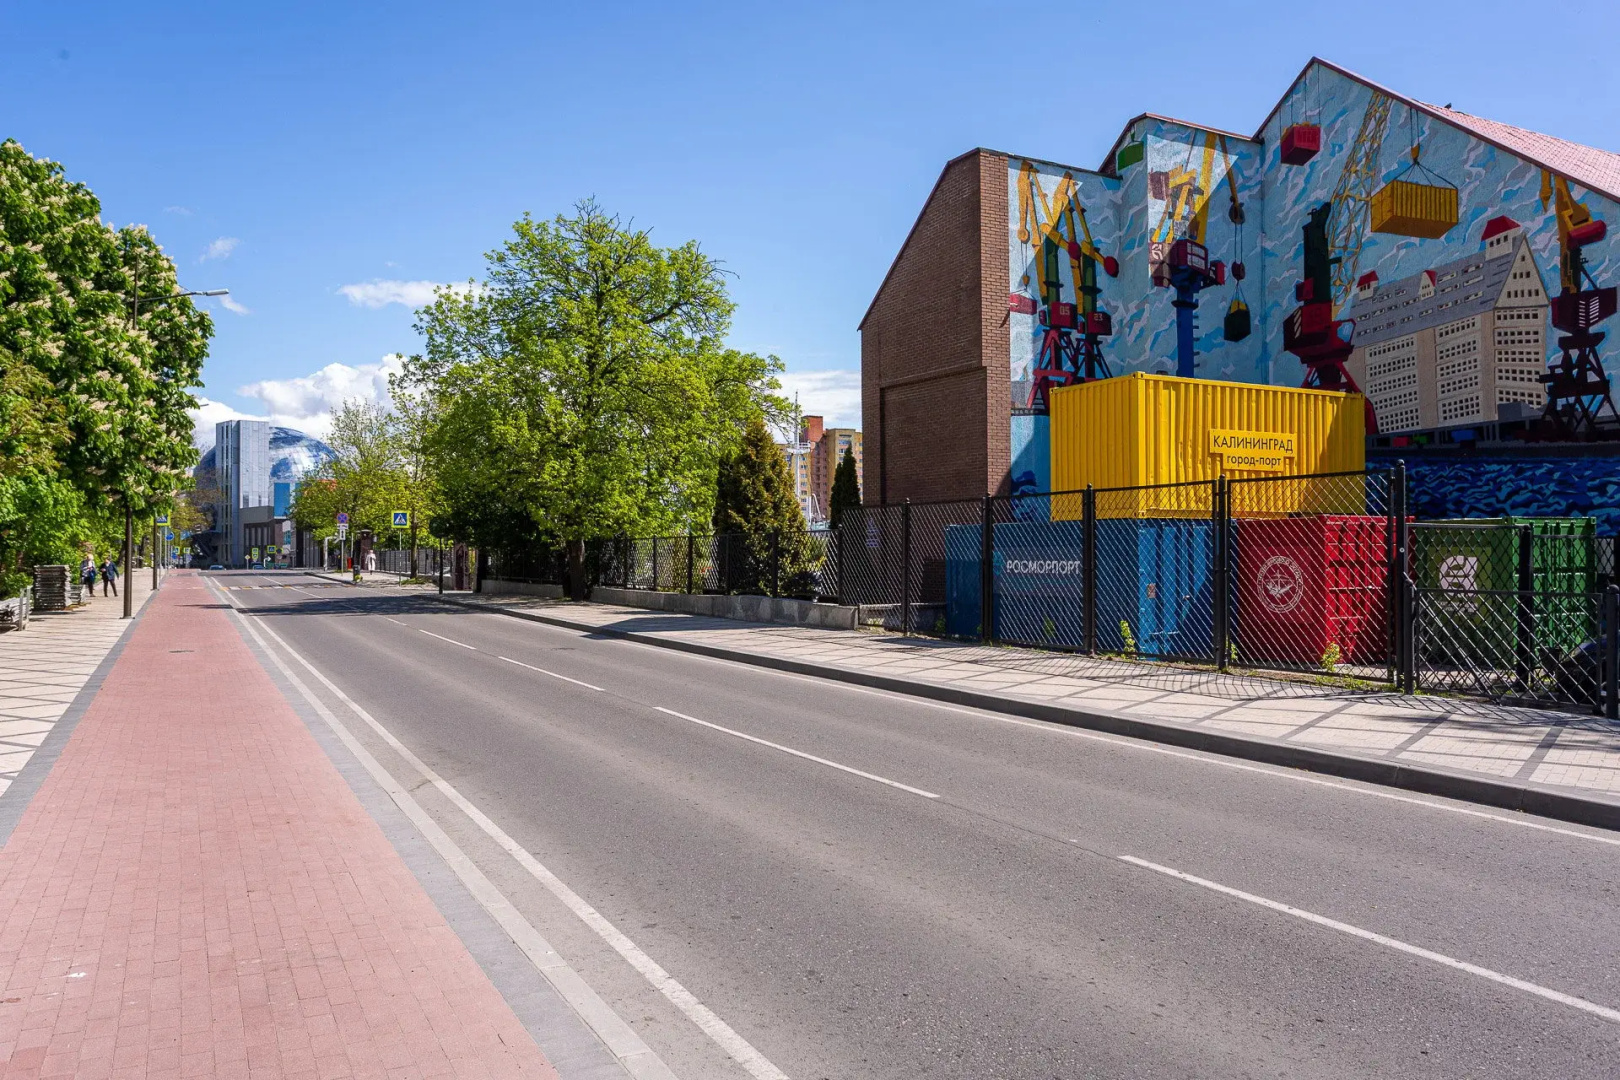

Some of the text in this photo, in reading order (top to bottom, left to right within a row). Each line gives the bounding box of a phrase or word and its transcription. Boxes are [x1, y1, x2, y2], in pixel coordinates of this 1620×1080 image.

[1213, 435, 1293, 454] КАЛИНИНГРАД
[1226, 456, 1281, 468] город-порт
[1006, 560, 1081, 575] РОСМОРПОРТ
